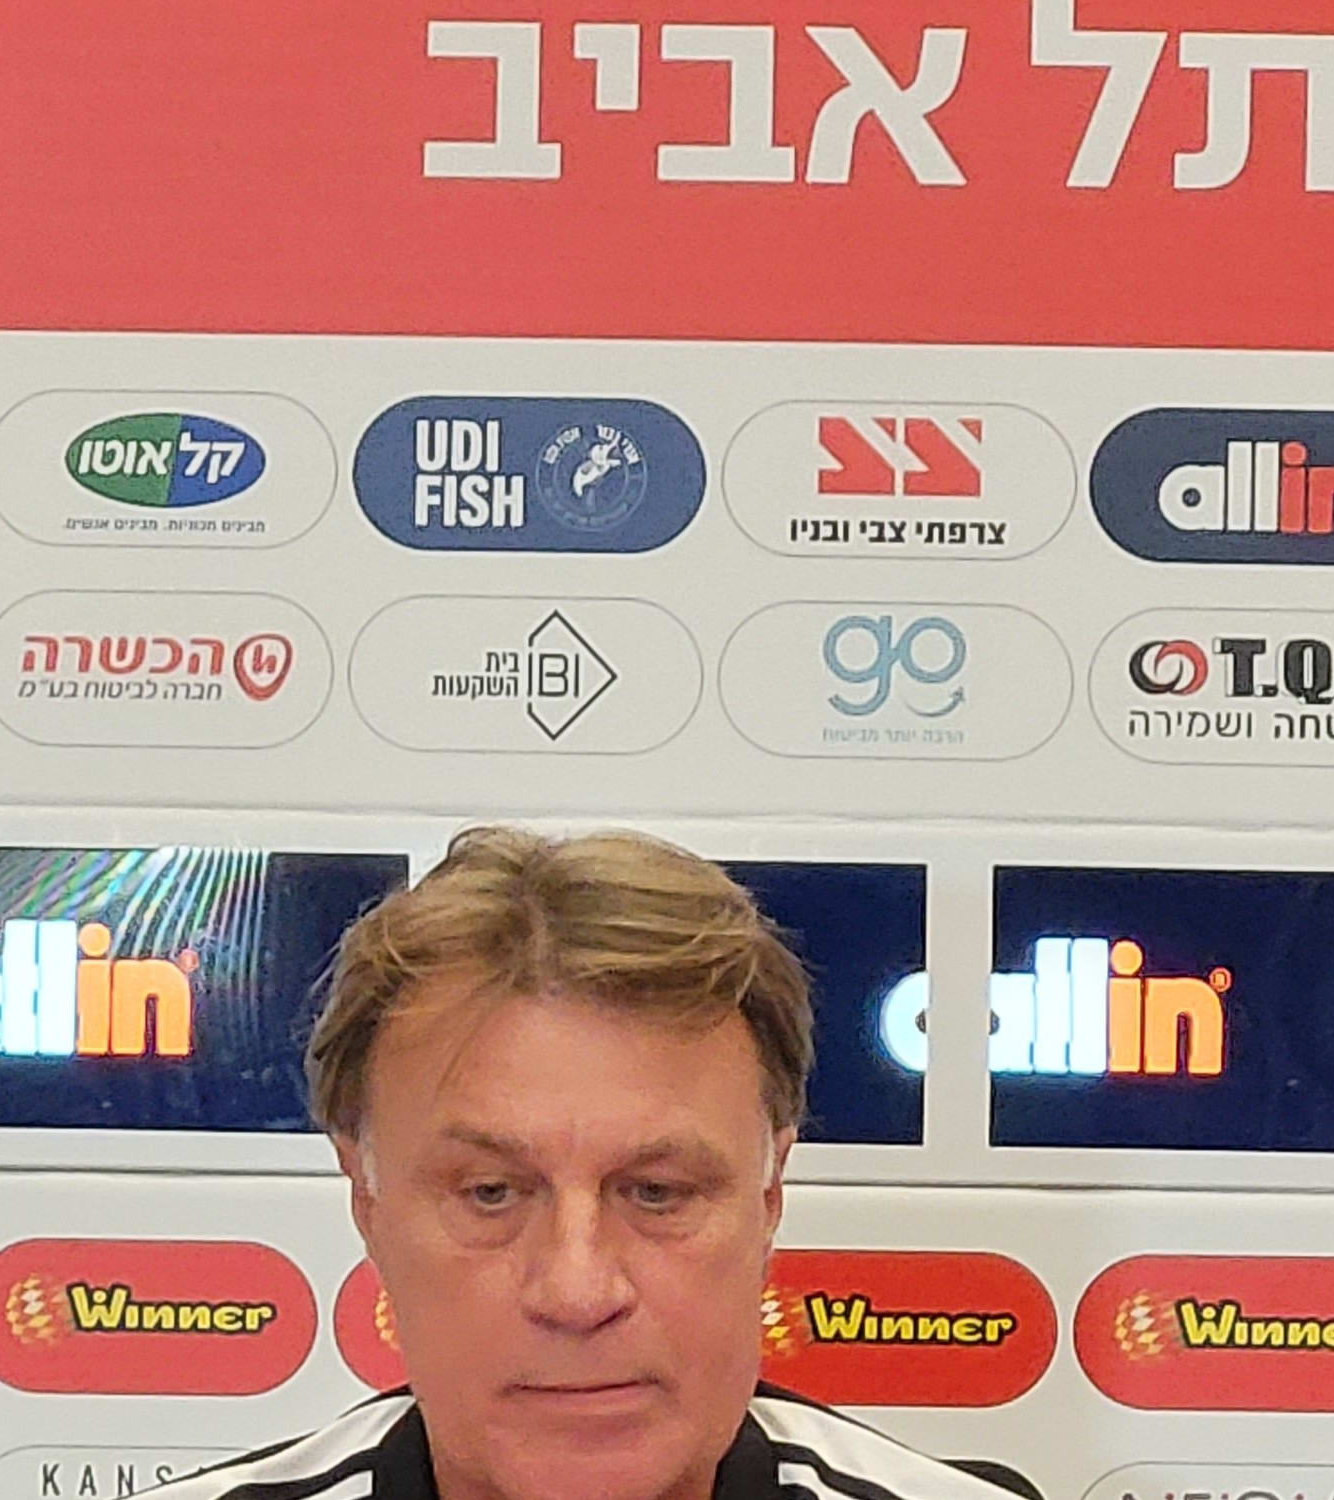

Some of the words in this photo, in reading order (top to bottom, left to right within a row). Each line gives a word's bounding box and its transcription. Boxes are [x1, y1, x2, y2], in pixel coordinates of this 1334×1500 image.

[423, 20, 967, 187] אביב
[75, 432, 177, 482] אוטו
[175, 425, 249, 483] קל
[414, 418, 501, 475] UDI
[415, 472, 526, 527] FISH
[791, 519, 849, 542] ובניו
[860, 521, 906, 542] צבי
[916, 522, 1005, 544] צרפתי
[23, 636, 224, 675] הכשרה
[486, 652, 519, 672] בית
[823, 616, 966, 718] go
[77, 674, 157, 699] לביטוח
[163, 683, 222, 700] חברה
[432, 676, 518, 699] השקעות
[1130, 711, 1251, 738] ושמירה
[65, 1282, 277, 1335] Winner
[805, 1293, 1016, 1345] Winner
